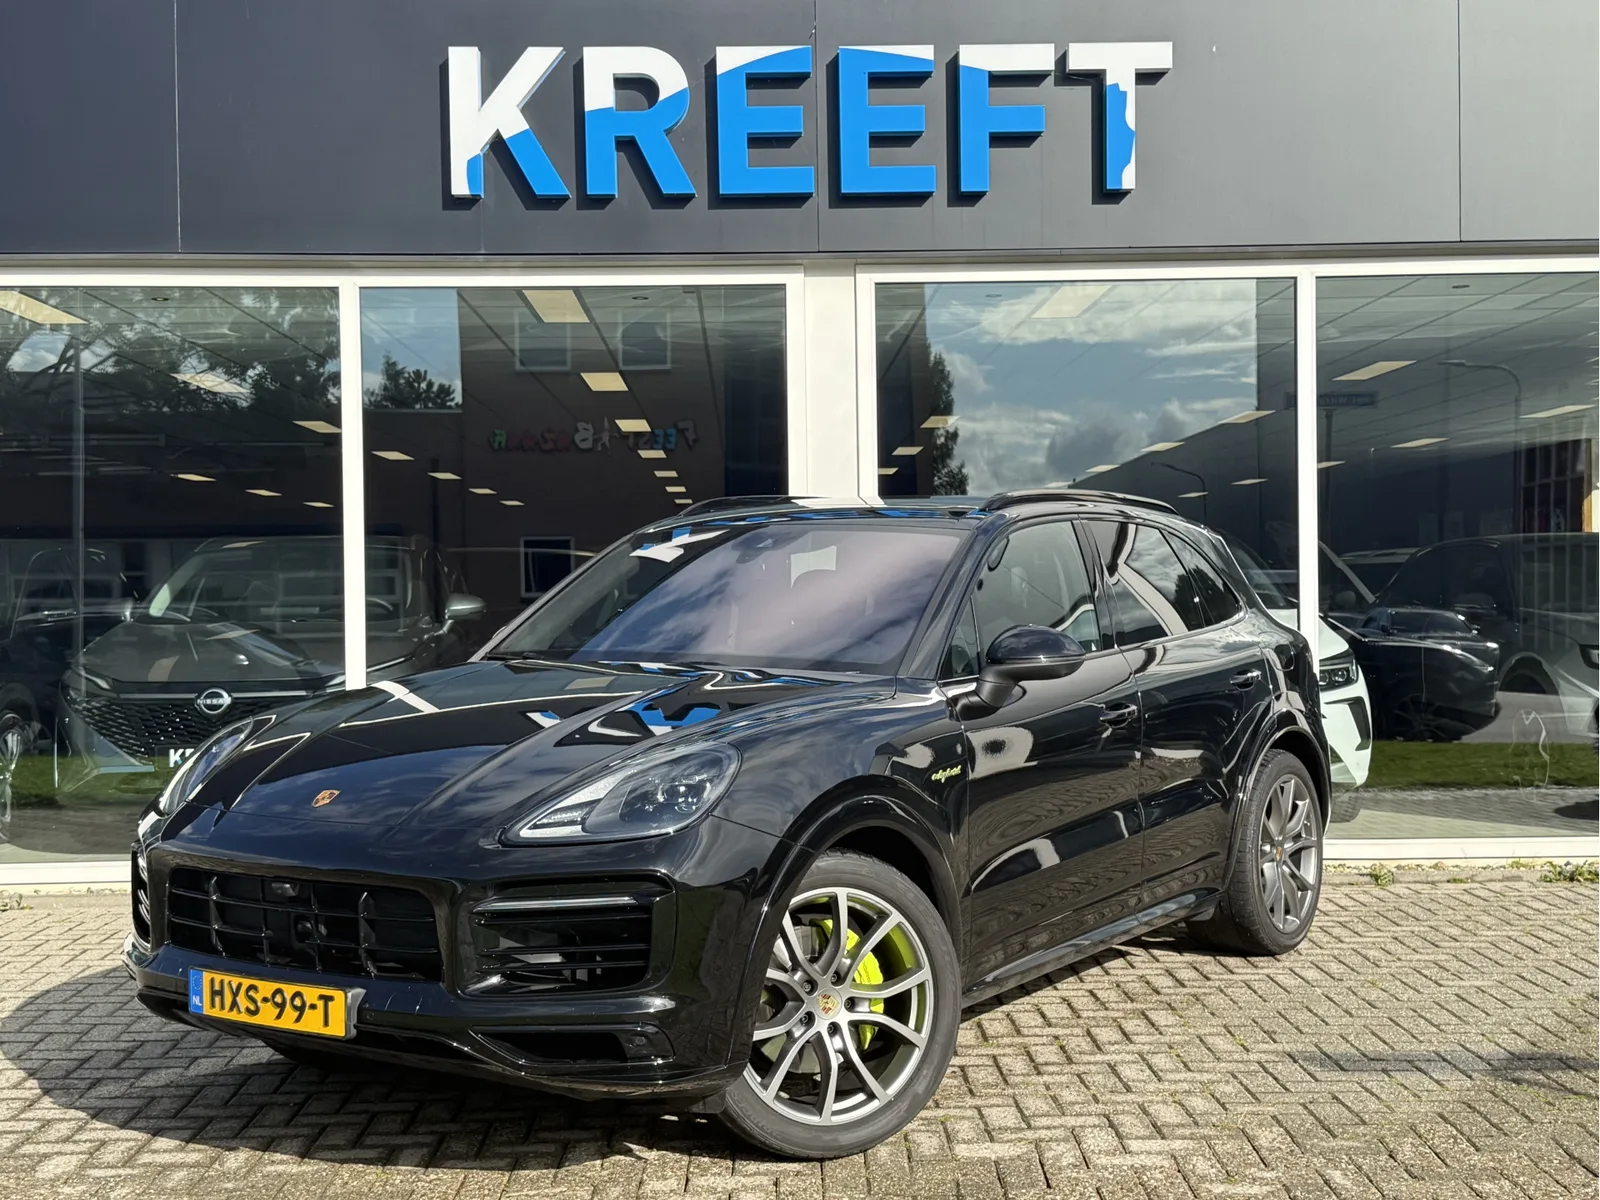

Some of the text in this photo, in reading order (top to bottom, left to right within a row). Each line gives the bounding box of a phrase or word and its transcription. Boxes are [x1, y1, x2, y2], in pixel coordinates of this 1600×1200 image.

[447, 42, 1173, 198] KREEFT
[169, 748, 195, 768] K
[192, 995, 203, 1006] NL
[209, 977, 335, 1028] HXS-99-T
